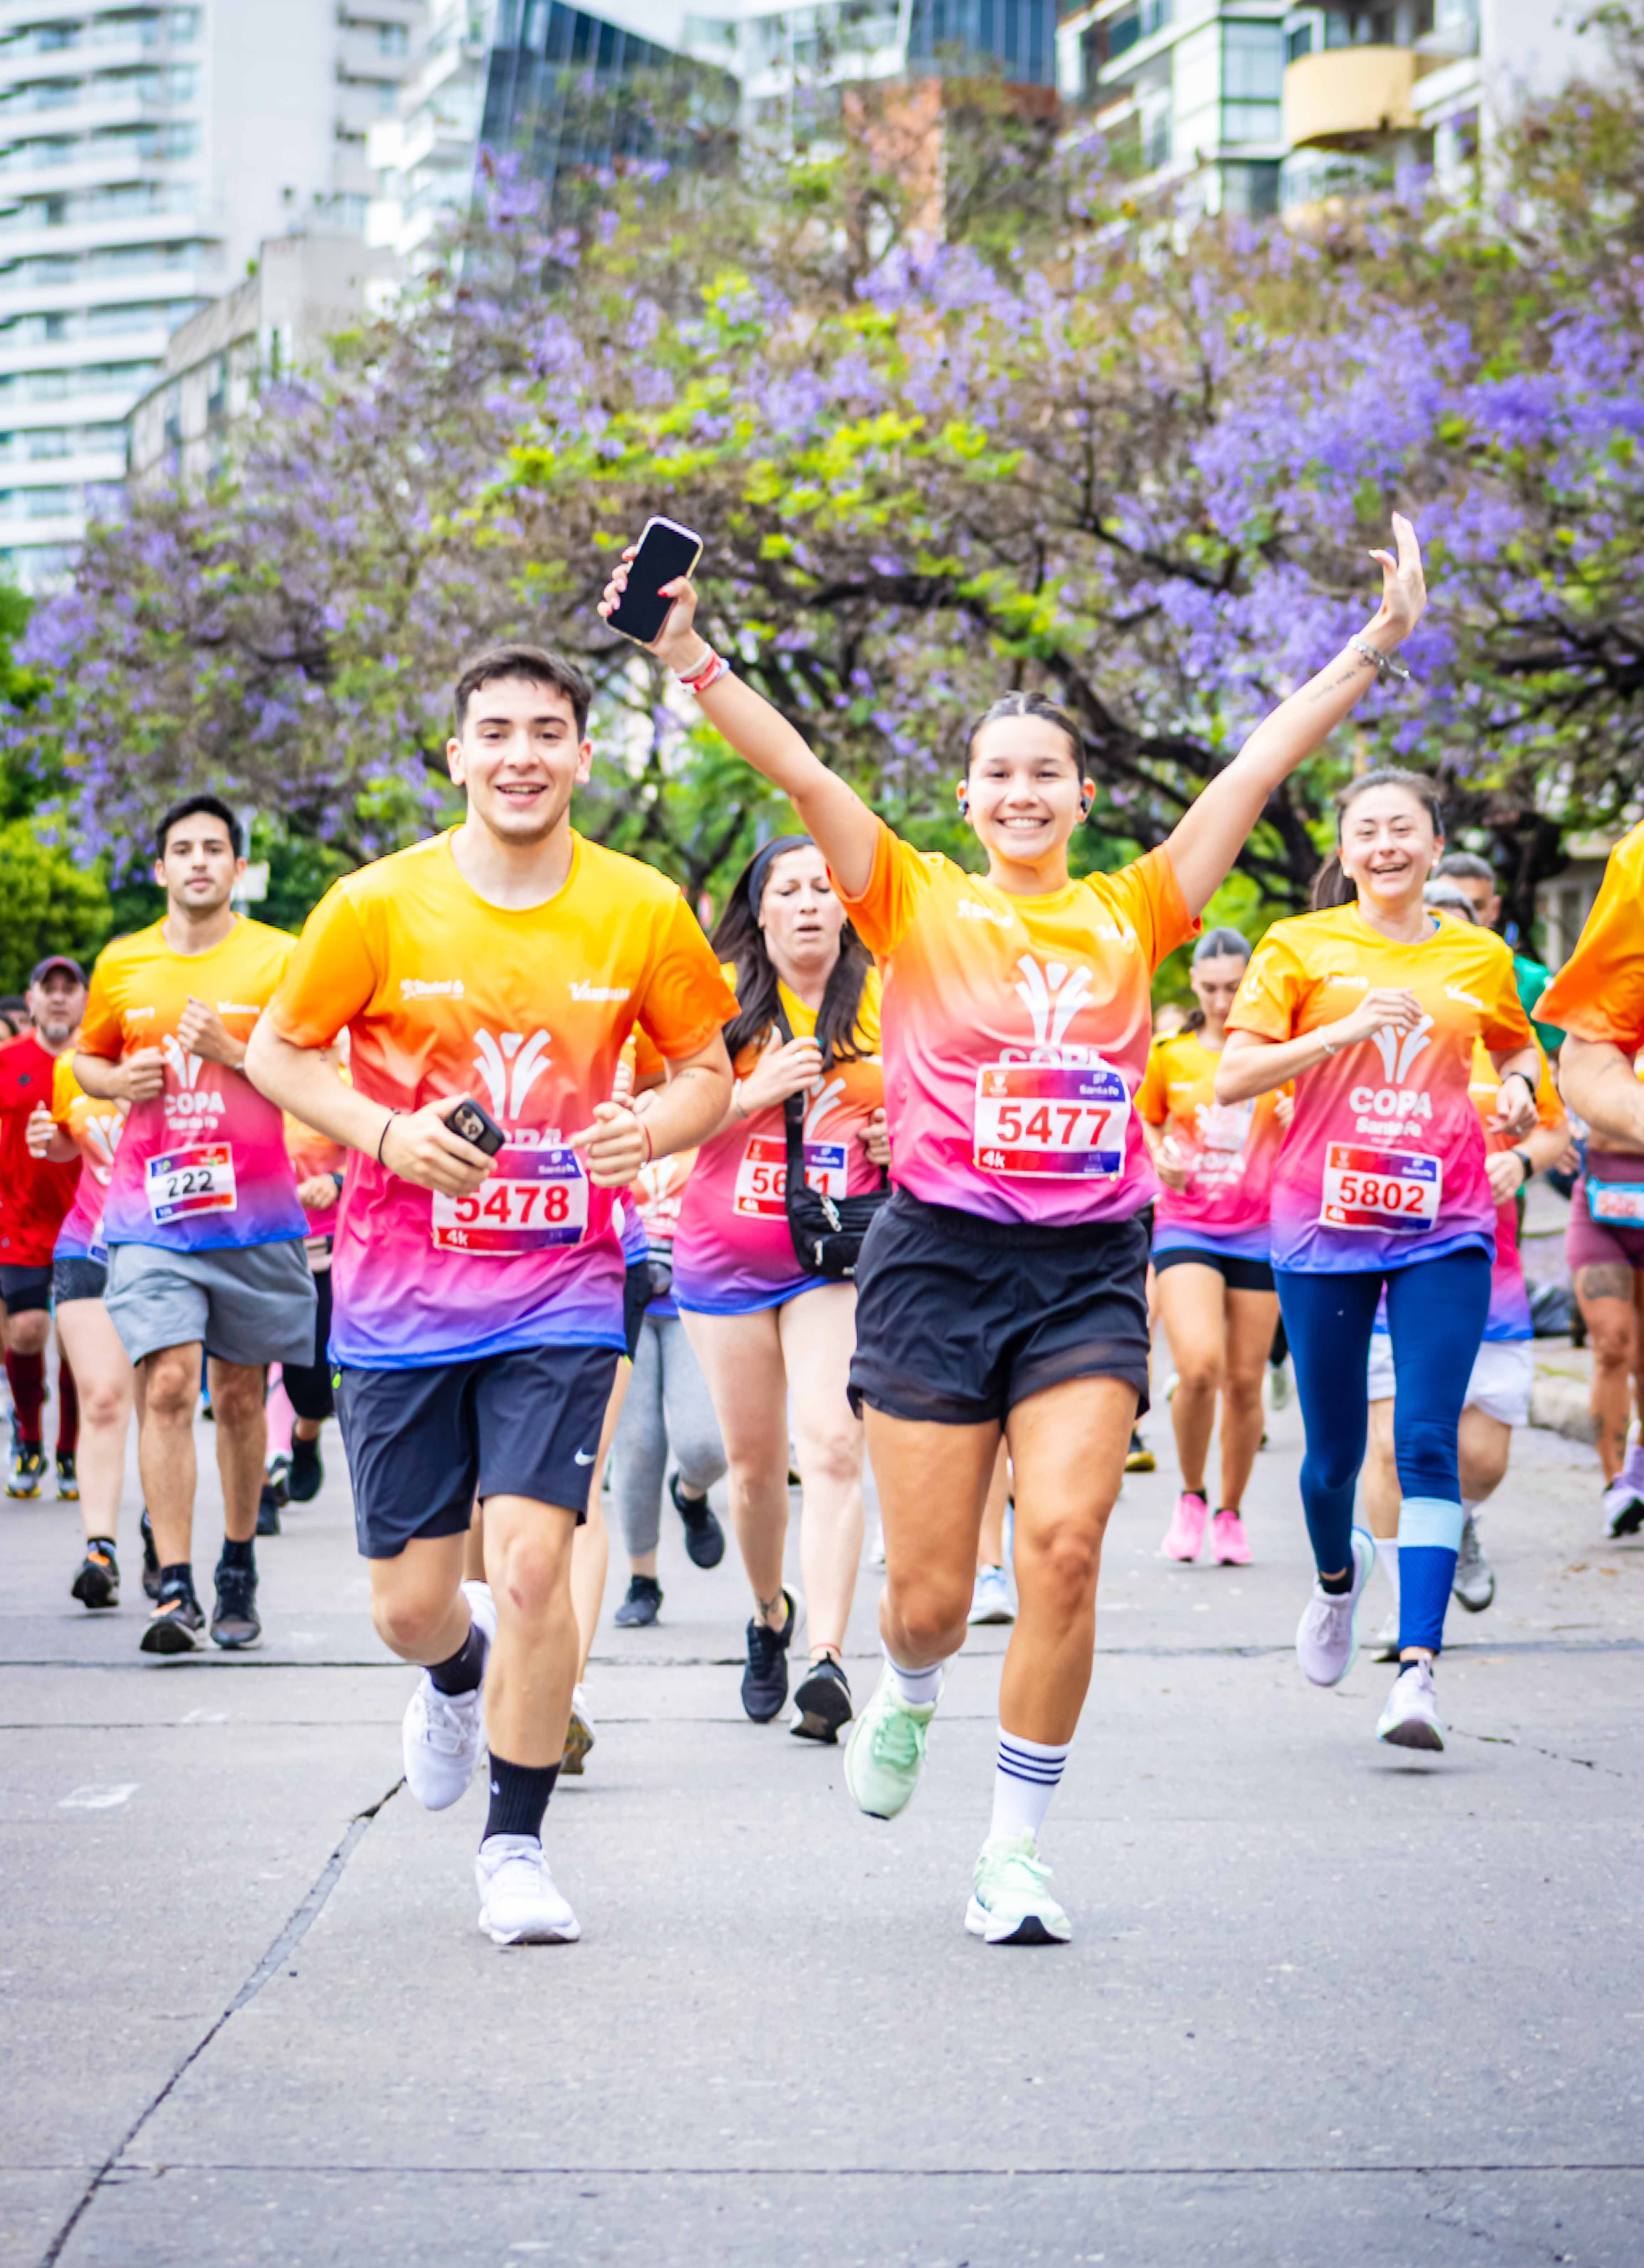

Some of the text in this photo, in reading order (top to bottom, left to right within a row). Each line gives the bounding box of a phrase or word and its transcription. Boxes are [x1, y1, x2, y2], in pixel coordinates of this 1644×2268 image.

[165, 1091, 226, 1116] COPA
[1350, 1086, 1432, 1119] COPA
[997, 1106, 1111, 1146] 5477
[982, 1150, 1006, 1169] 4k
[166, 1170, 215, 1198] 222
[752, 1167, 829, 1197] 561
[1339, 1176, 1424, 1213] 5802
[454, 1185, 570, 1223] 5478
[446, 1229, 469, 1246] 4k
